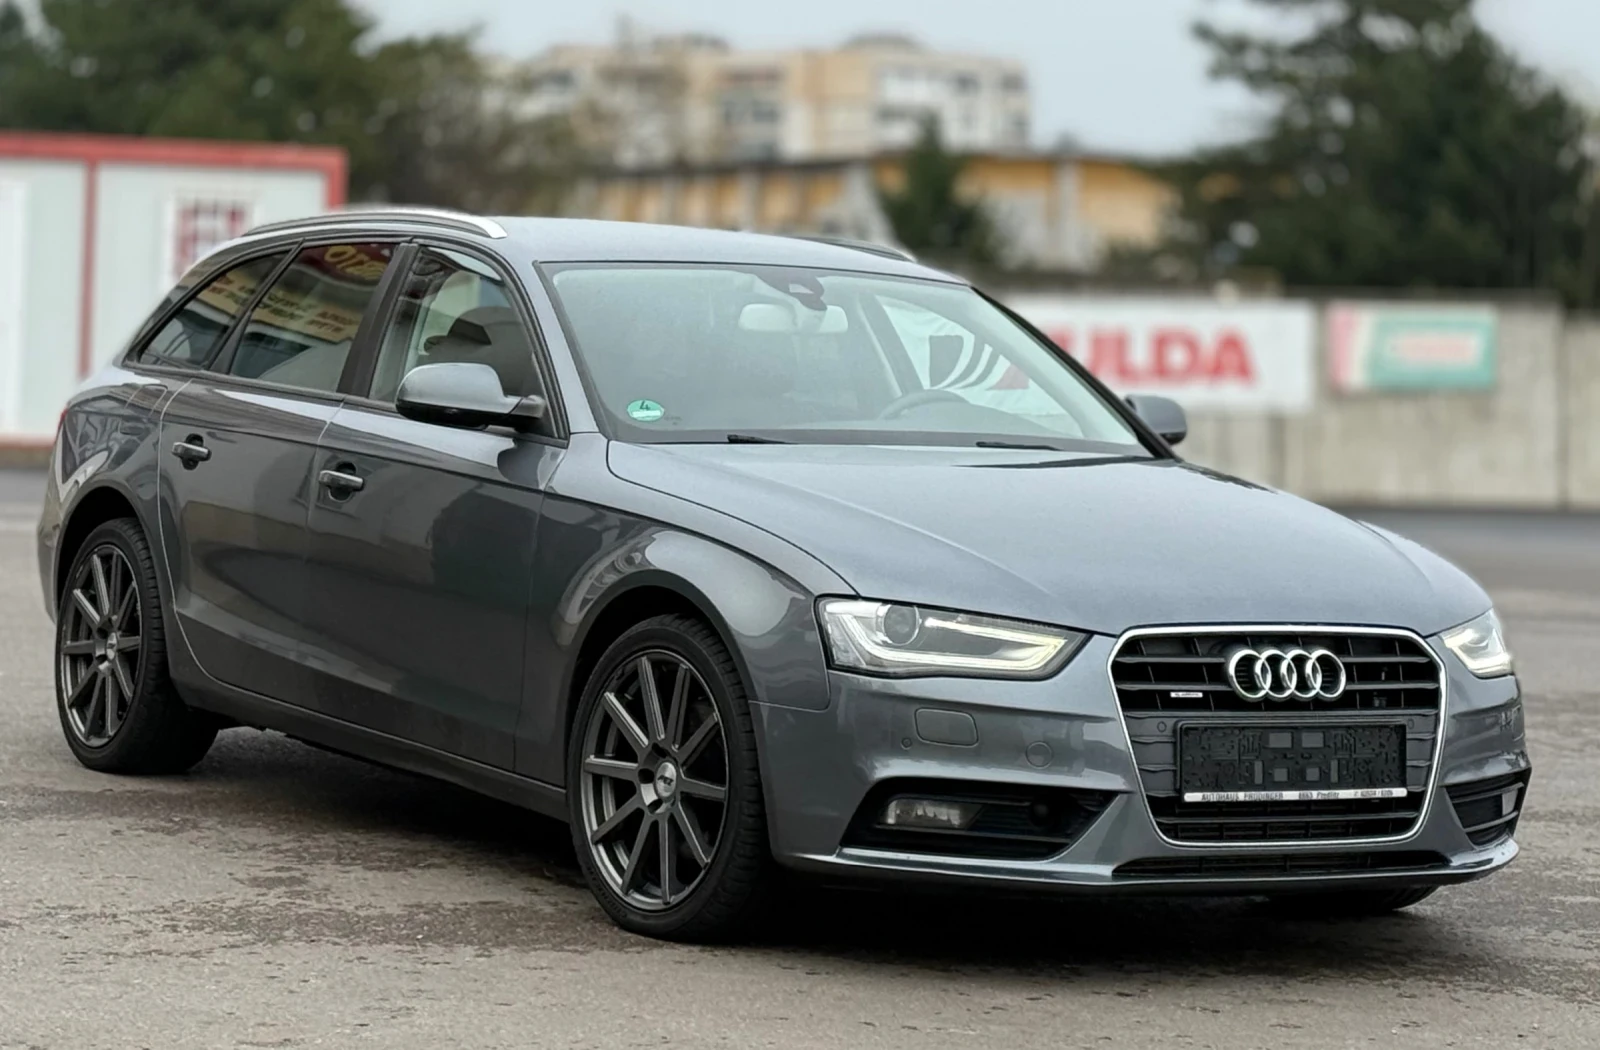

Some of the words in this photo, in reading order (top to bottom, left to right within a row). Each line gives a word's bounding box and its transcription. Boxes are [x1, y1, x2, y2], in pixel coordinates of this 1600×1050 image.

[1042, 326, 1257, 387] ULDA
[639, 400, 650, 411] 4
[1202, 791, 1239, 801] AUTOHAUS
